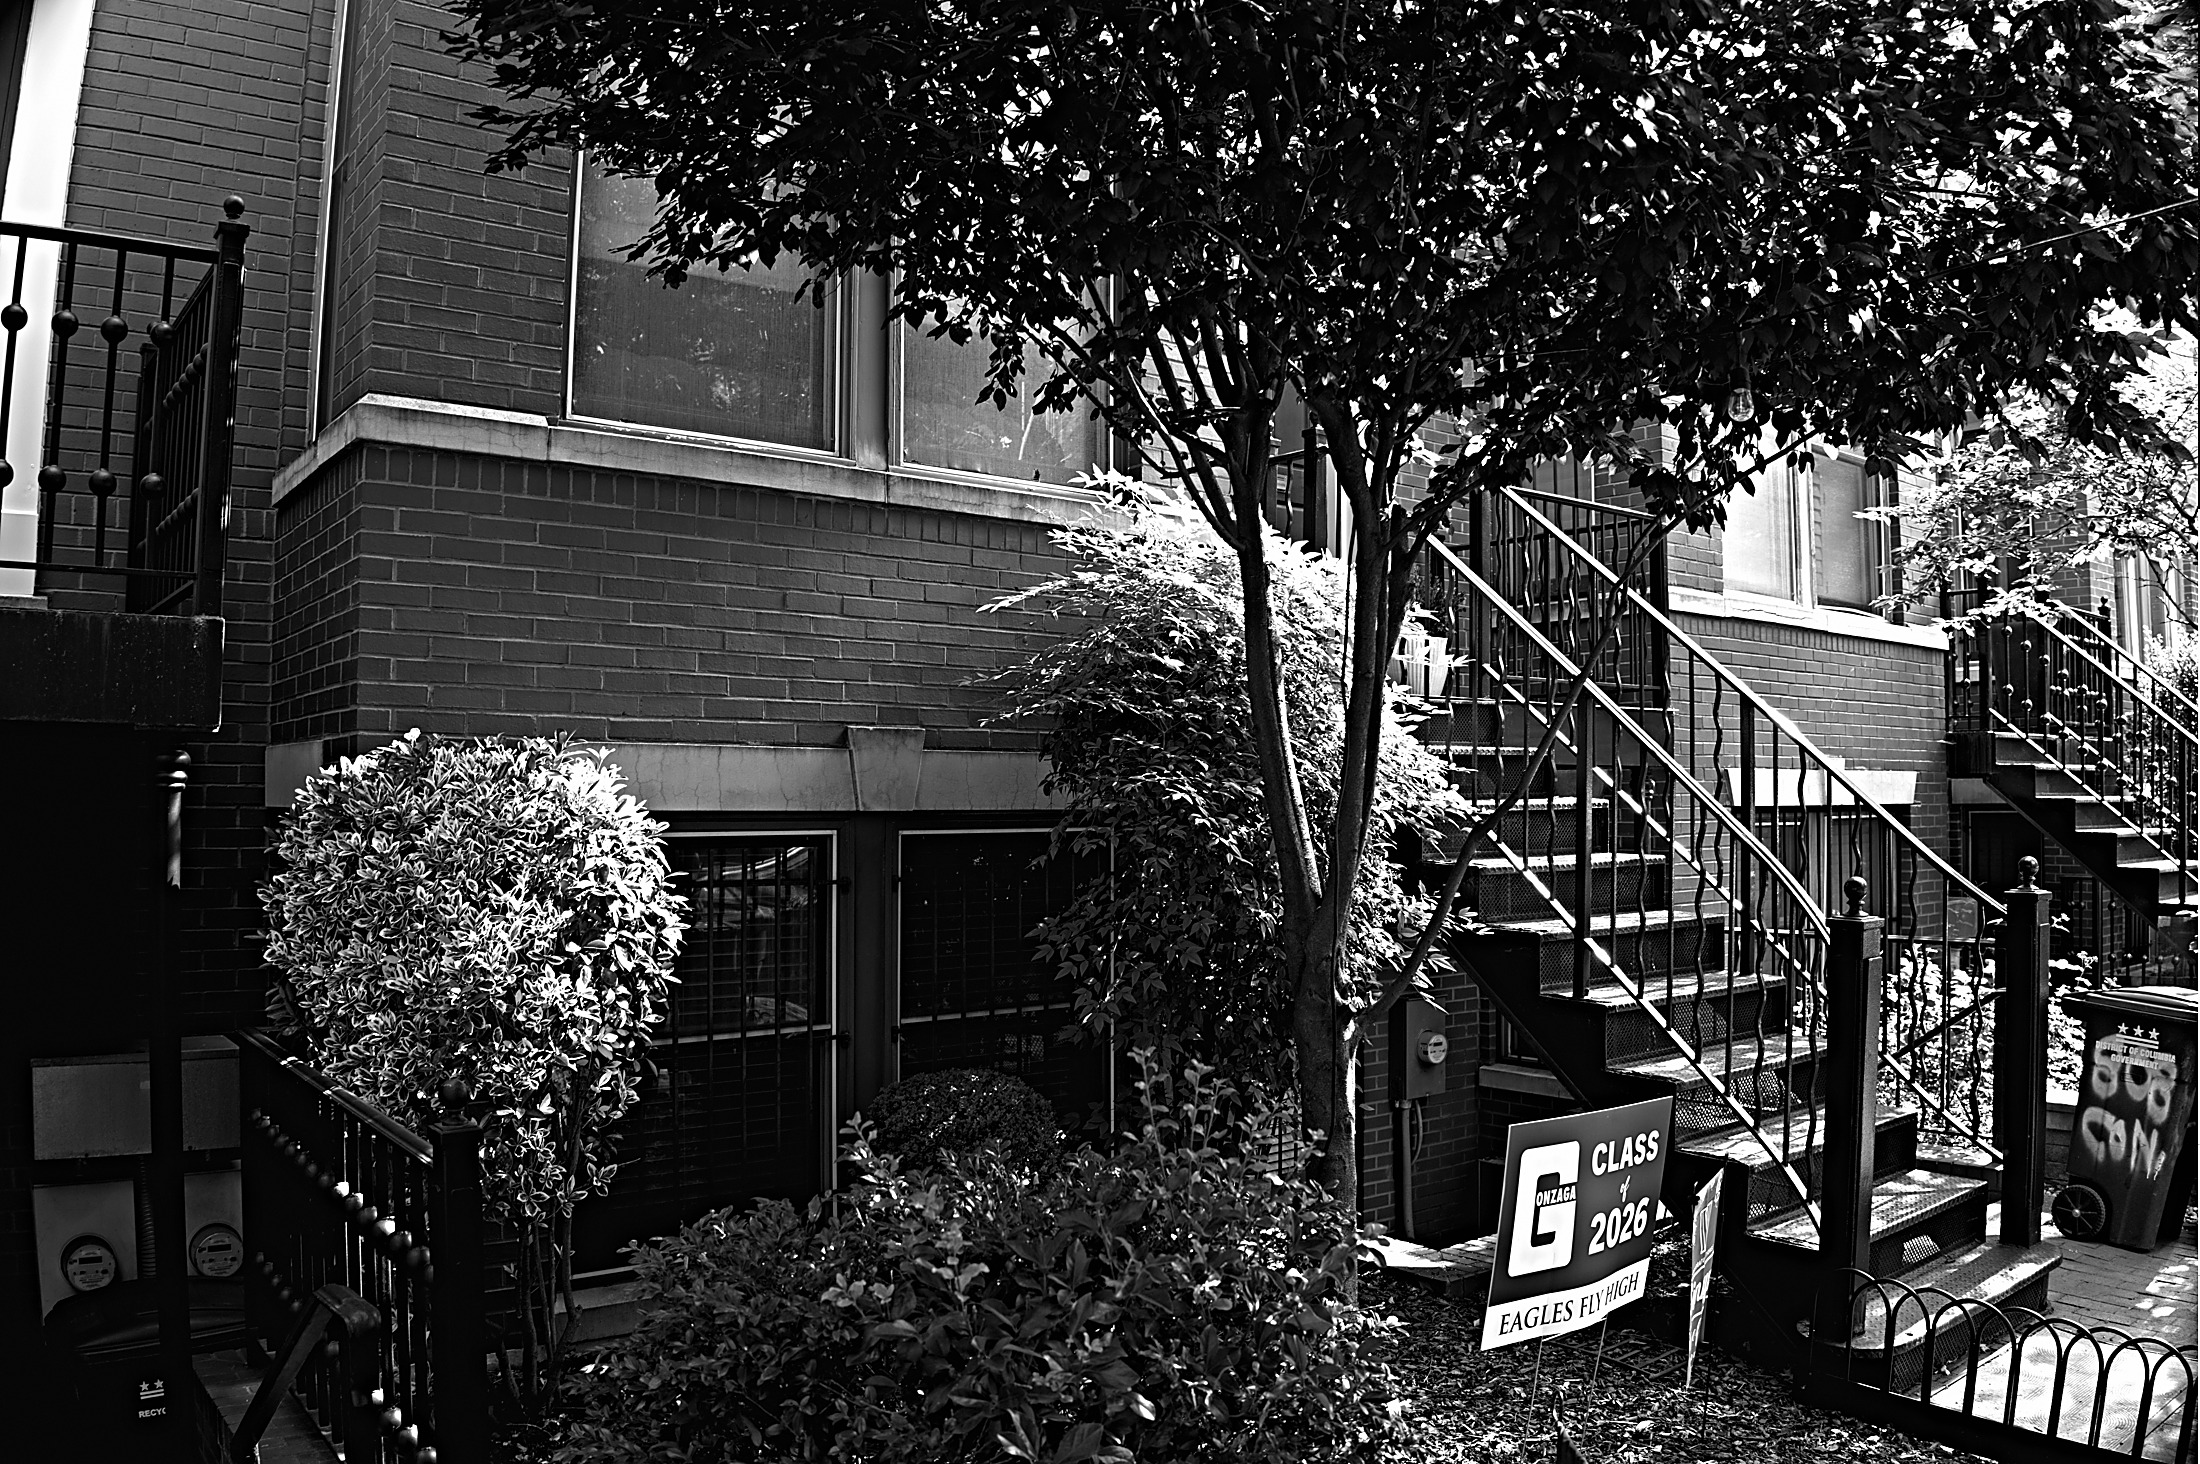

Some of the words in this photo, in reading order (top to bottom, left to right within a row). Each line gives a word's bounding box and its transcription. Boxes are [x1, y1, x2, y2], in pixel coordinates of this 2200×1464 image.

[2095, 1040, 2128, 1054] DISTRICT
[2129, 1046, 2139, 1056] OF
[2140, 1049, 2176, 1064] COLUMBIA
[2110, 1053, 2159, 1070] GOVERNMENT
[1591, 1129, 1660, 1177] CLASS
[1619, 1174, 1631, 1203] of
[1588, 1196, 1650, 1256] 2026
[1498, 1299, 1574, 1337] EAGLES
[1578, 1289, 1605, 1319] FLY
[1605, 1271, 1640, 1306] HIGH
